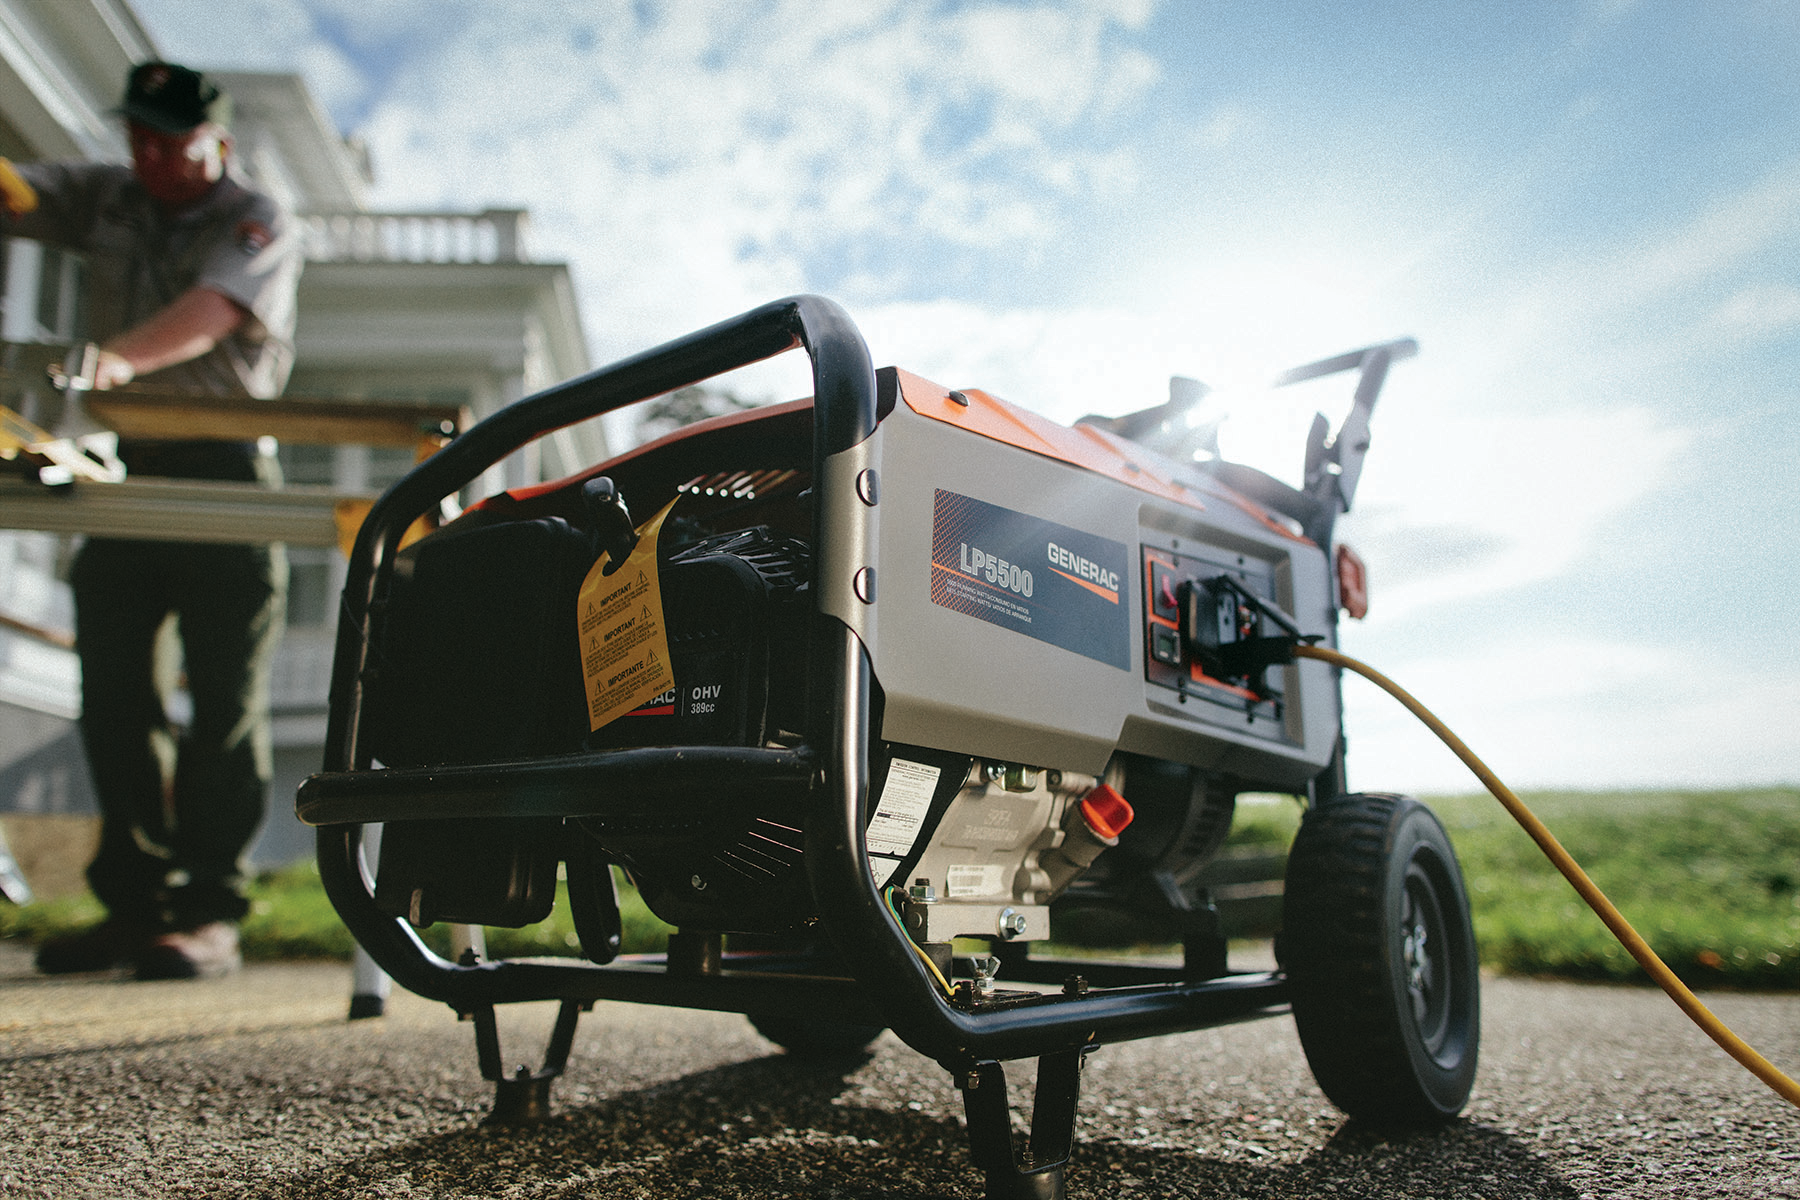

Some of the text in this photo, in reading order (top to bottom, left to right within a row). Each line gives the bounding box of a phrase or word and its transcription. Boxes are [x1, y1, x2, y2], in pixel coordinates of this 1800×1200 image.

[960, 542, 1033, 598] LP5500
[1048, 542, 1119, 591] GENERAC
[600, 582, 631, 607] IMPORTANT
[604, 617, 635, 642] IMPORTANT
[608, 660, 644, 687] IMPORTANTE
[692, 685, 721, 700] OHV
[690, 703, 715, 714] 389cc
